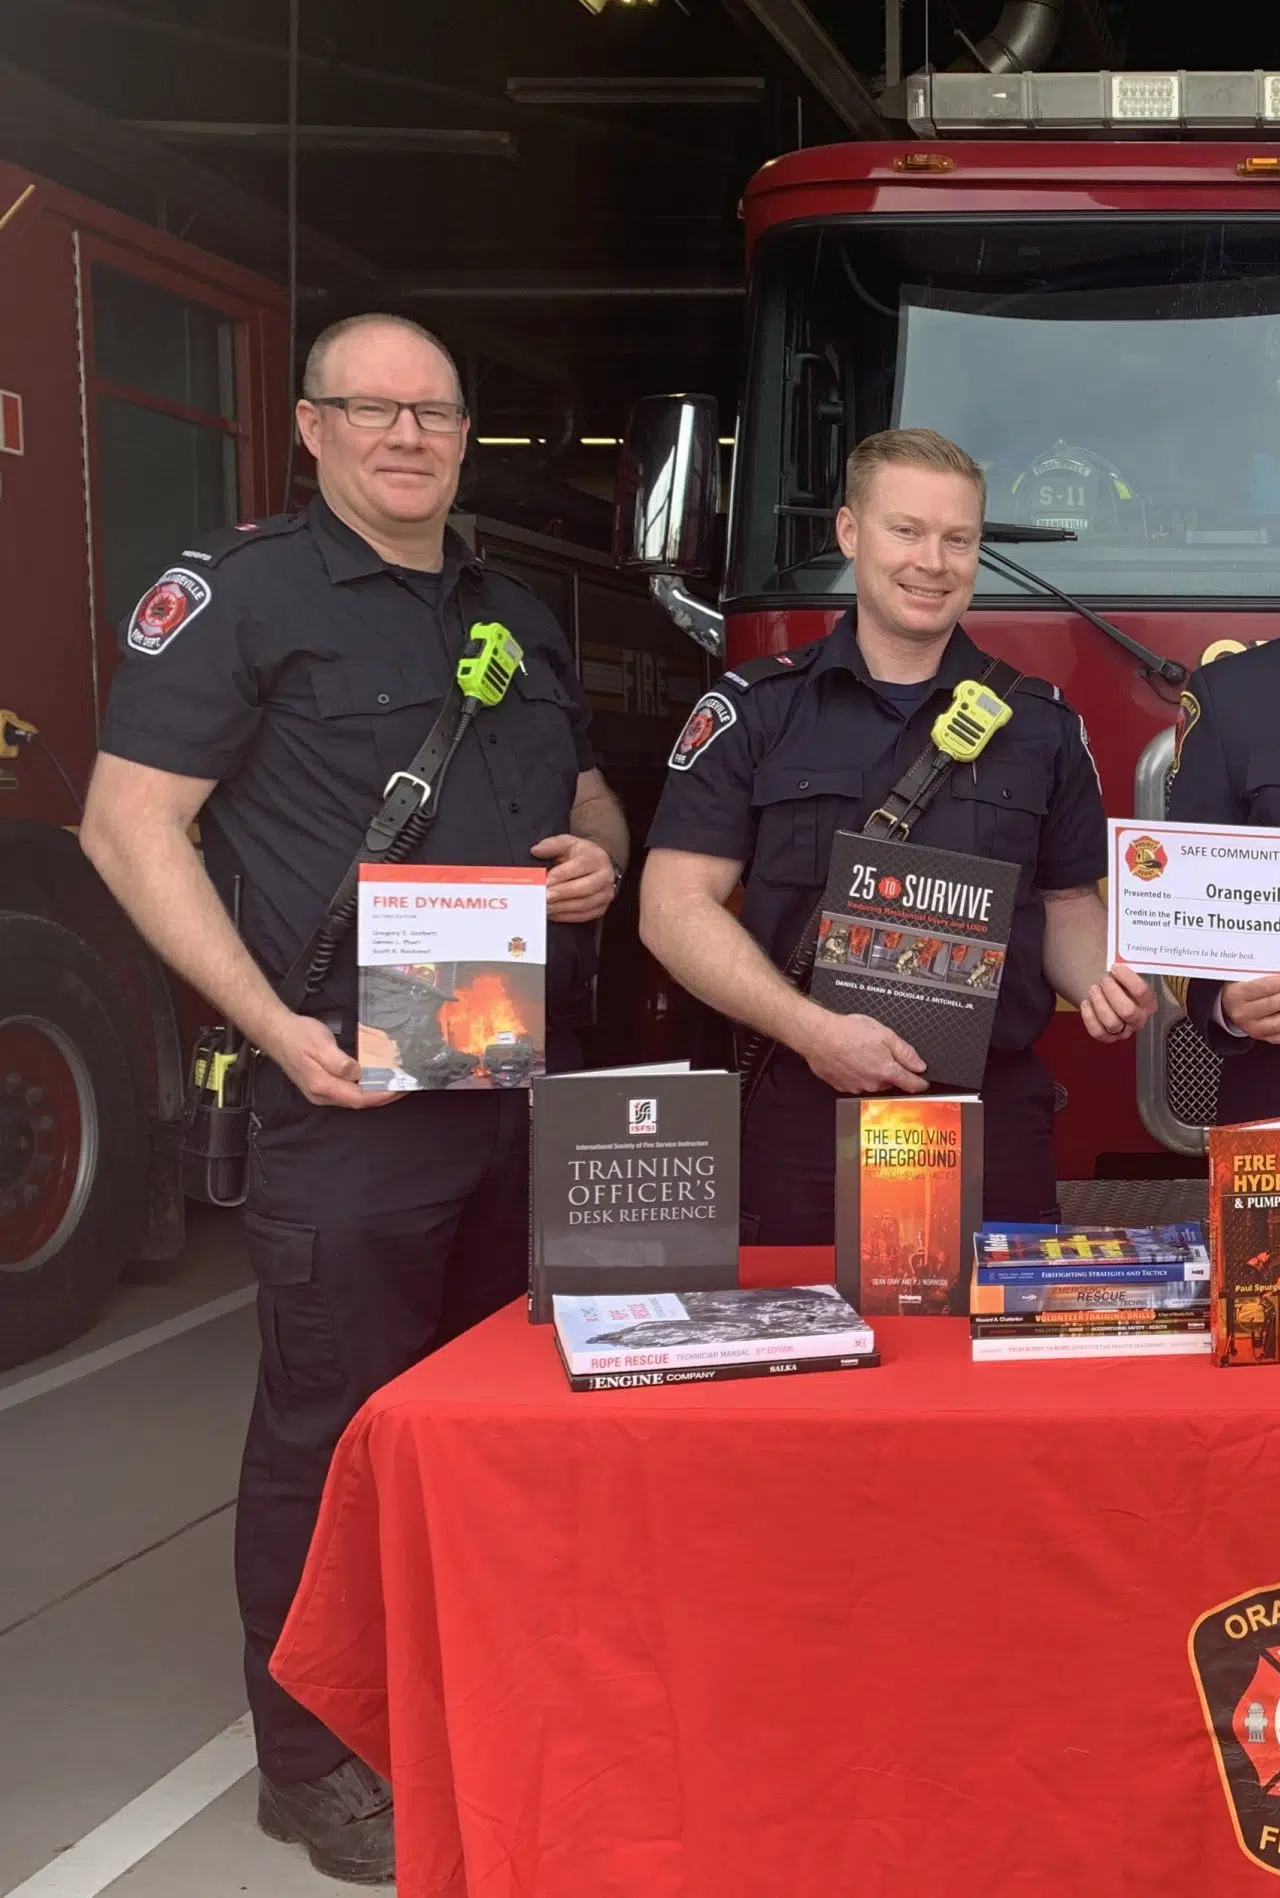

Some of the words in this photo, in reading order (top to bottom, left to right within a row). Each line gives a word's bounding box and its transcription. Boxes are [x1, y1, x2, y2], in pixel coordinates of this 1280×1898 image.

[1039, 485, 1085, 506] S-11
[623, 650, 669, 716] FIRE
[1180, 845, 1207, 857] SAFE
[849, 864, 877, 900] 25
[884, 880, 896, 895] TO
[902, 874, 994, 922] SURVIVE
[1124, 888, 1161, 899] Presented
[1162, 892, 1172, 900] to
[373, 896, 409, 909] FIRE
[415, 896, 508, 909] DYNAMICS
[1125, 908, 1148, 917] Credit
[1149, 909, 1156, 918] in
[1158, 911, 1171, 919] the
[1174, 911, 1204, 928] Five
[1131, 919, 1161, 928] amount
[1163, 920, 1172, 928] of
[1159, 945, 1200, 957] Firefighters
[1201, 949, 1209, 957] to
[1210, 949, 1219, 958] be
[1220, 950, 1237, 959] their
[1238, 951, 1256, 960] best.
[835, 979, 858, 990] DANIEL
[866, 984, 886, 994] SHAW
[893, 990, 925, 1001] DOUGLAS
[631, 1124, 656, 1132] ISFSI
[864, 1129, 889, 1145] THE
[895, 1129, 957, 1146] EVOLVING
[864, 1148, 957, 1168] FIREGROUND
[1233, 1154, 1276, 1172] FIRE
[568, 1156, 715, 1181] TRAINING
[568, 1180, 716, 1206] OFFICER'S
[1234, 1198, 1244, 1208] &
[1247, 1195, 1280, 1208] PUMP
[569, 1209, 614, 1225] DESK
[619, 1205, 716, 1222] REFERENCE
[1041, 1271, 1087, 1279] FIREFIGHTING
[1088, 1270, 1125, 1278] STRATEGIES
[1126, 1269, 1140, 1277] AND
[1142, 1269, 1168, 1277] TACTICS
[1077, 1291, 1127, 1301] RESCUE
[1235, 1284, 1252, 1293] Paul
[591, 1357, 621, 1369] ROPE
[625, 1353, 670, 1367] RESCUE
[676, 1351, 719, 1361] TECHNICIAN
[720, 1348, 750, 1358] MANUAL
[770, 1363, 797, 1373] SALKA
[594, 1373, 664, 1389] ENGINE
[666, 1371, 716, 1382] COMPANY
